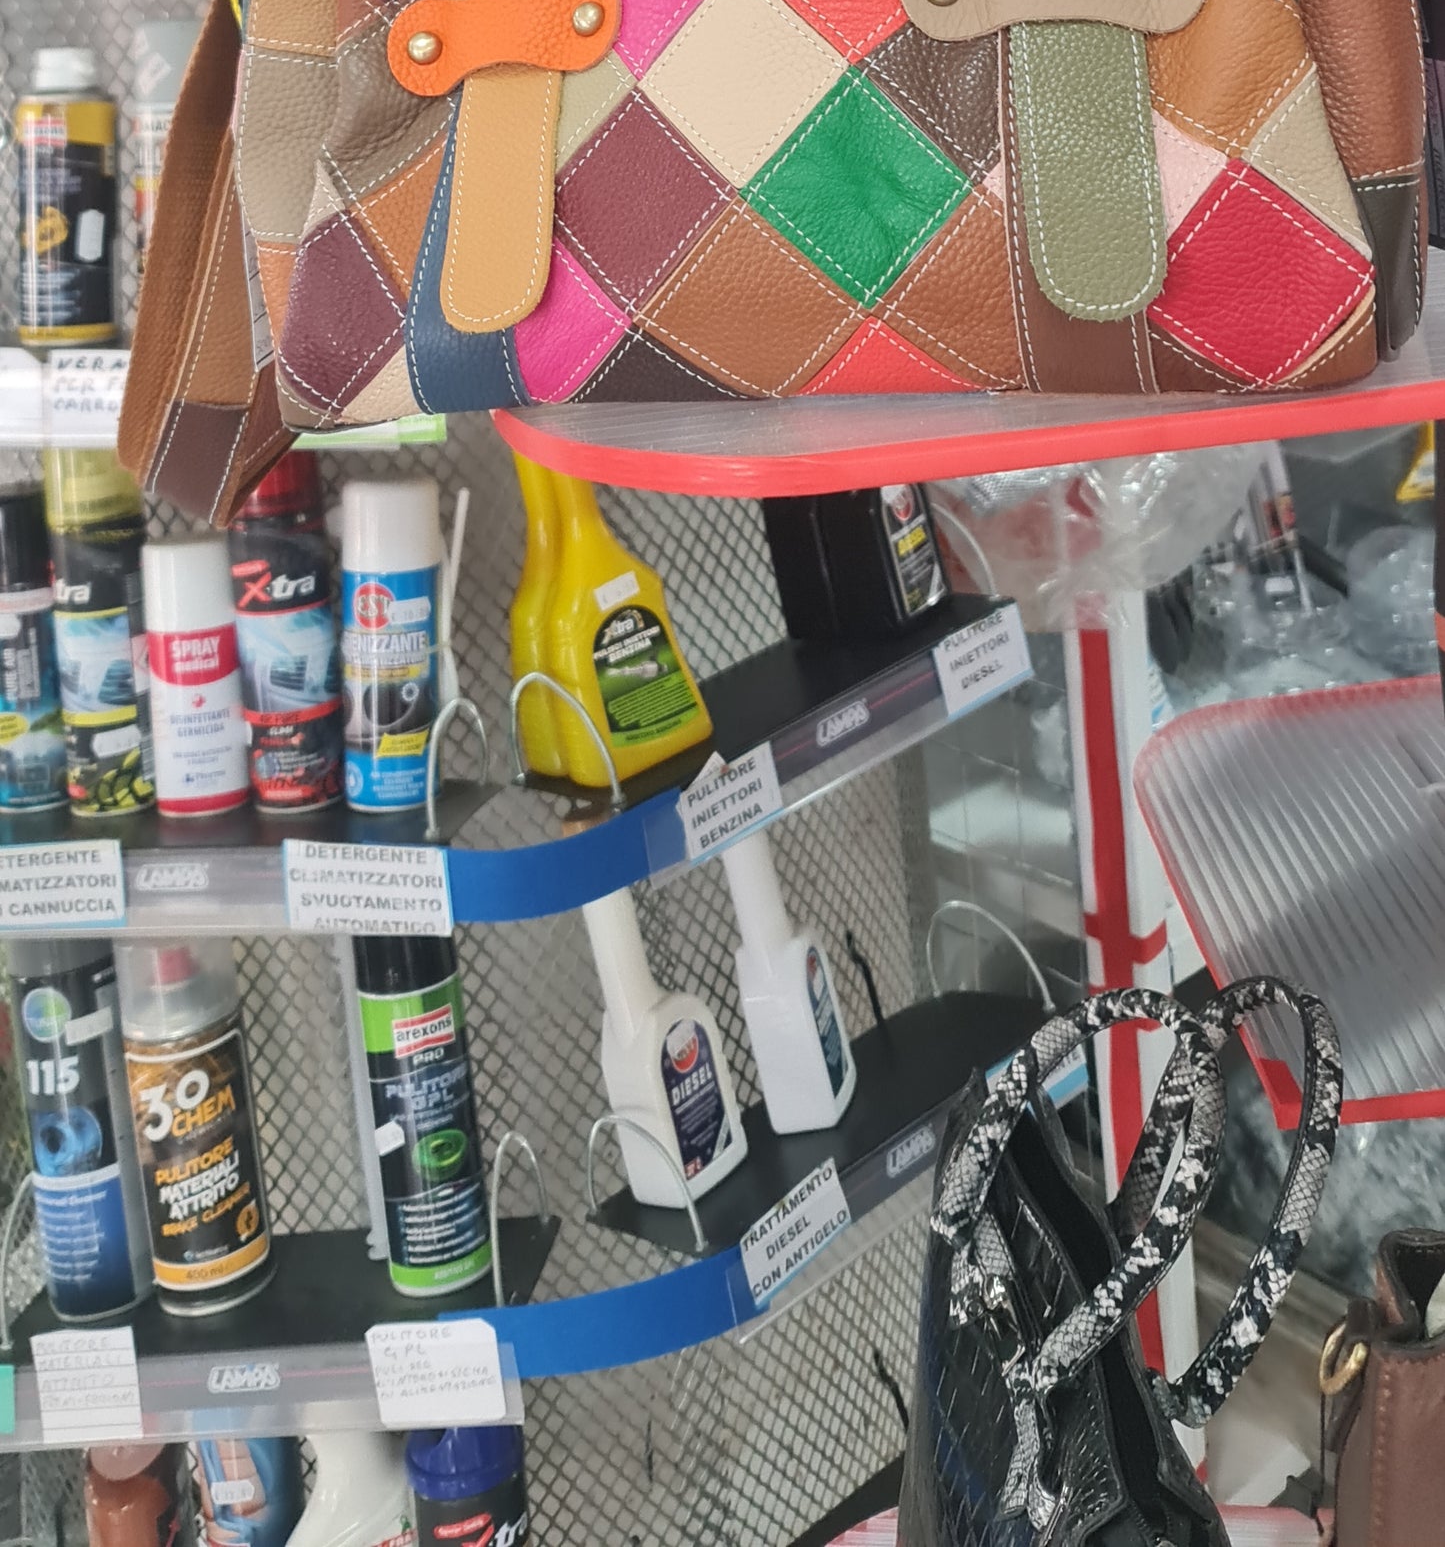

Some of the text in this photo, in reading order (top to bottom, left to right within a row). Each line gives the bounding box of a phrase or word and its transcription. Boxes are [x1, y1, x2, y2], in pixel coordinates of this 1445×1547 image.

[52, 579, 92, 603] tra
[171, 636, 220, 660] SPRAY
[943, 610, 1003, 652] PULITORE
[950, 631, 1010, 671] INIETTORI
[961, 659, 1003, 689] DIESEL
[687, 757, 757, 807] PULITORE
[691, 777, 762, 829] INIETTORI
[700, 803, 763, 848] BENZINA
[305, 844, 427, 864] DETERGENTE
[289, 868, 443, 889] CLIMATIZZATORI
[9, 898, 116, 917] CANNUCCIA
[301, 892, 442, 912] SVUOTAMENTO
[396, 1012, 452, 1042] arexons
[26, 1052, 80, 1096] 115
[413, 1047, 444, 1066] PRO
[671, 1062, 713, 1106] DIESEL
[171, 1084, 236, 1137] CHEM
[155, 1136, 234, 1186] PULITORE
[159, 1150, 240, 1203] MATERIALI
[169, 1172, 240, 1221] ATTRITO
[741, 1167, 833, 1252] TRATTAMENTO
[752, 1209, 848, 1298] CON ANTIGELO
[765, 1215, 811, 1260] DIESEL
